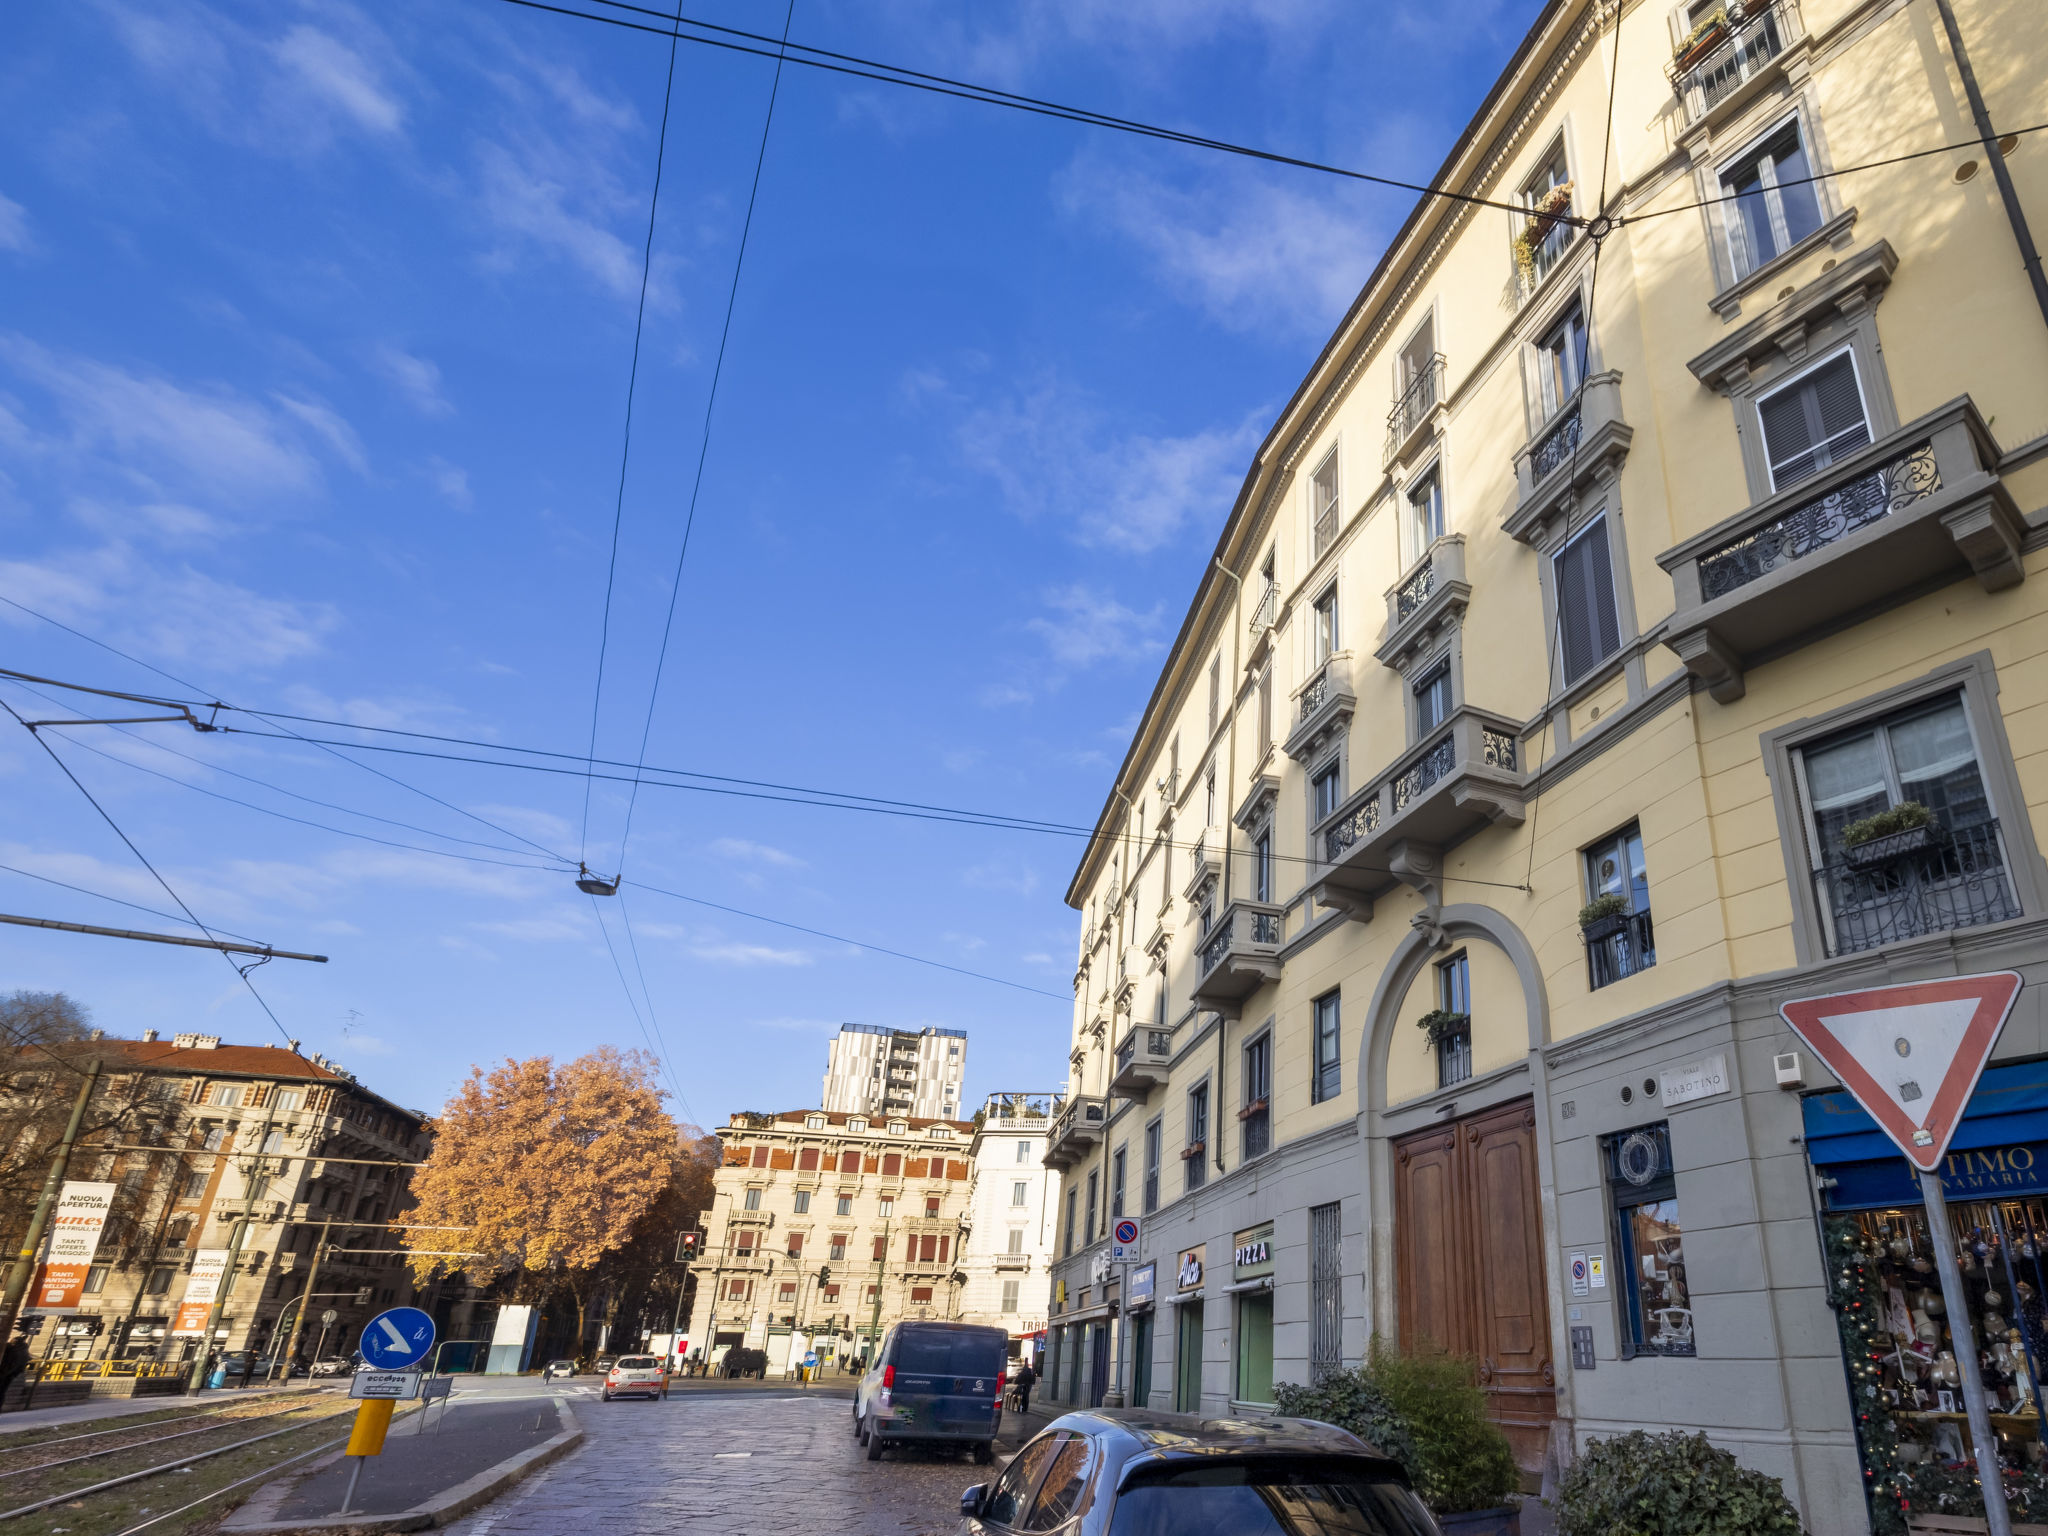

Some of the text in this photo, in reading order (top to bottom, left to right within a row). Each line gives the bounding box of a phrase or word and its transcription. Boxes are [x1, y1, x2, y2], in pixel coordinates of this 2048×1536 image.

[1666, 1075, 1721, 1097] SABOTINO
[1909, 1147, 2034, 1181] ITIMO
[1914, 1172, 2038, 1191] ANAMARIA
[59, 1201, 108, 1209] APERTURA
[55, 1216, 103, 1226] unes
[1235, 1242, 1267, 1268] PIZZA
